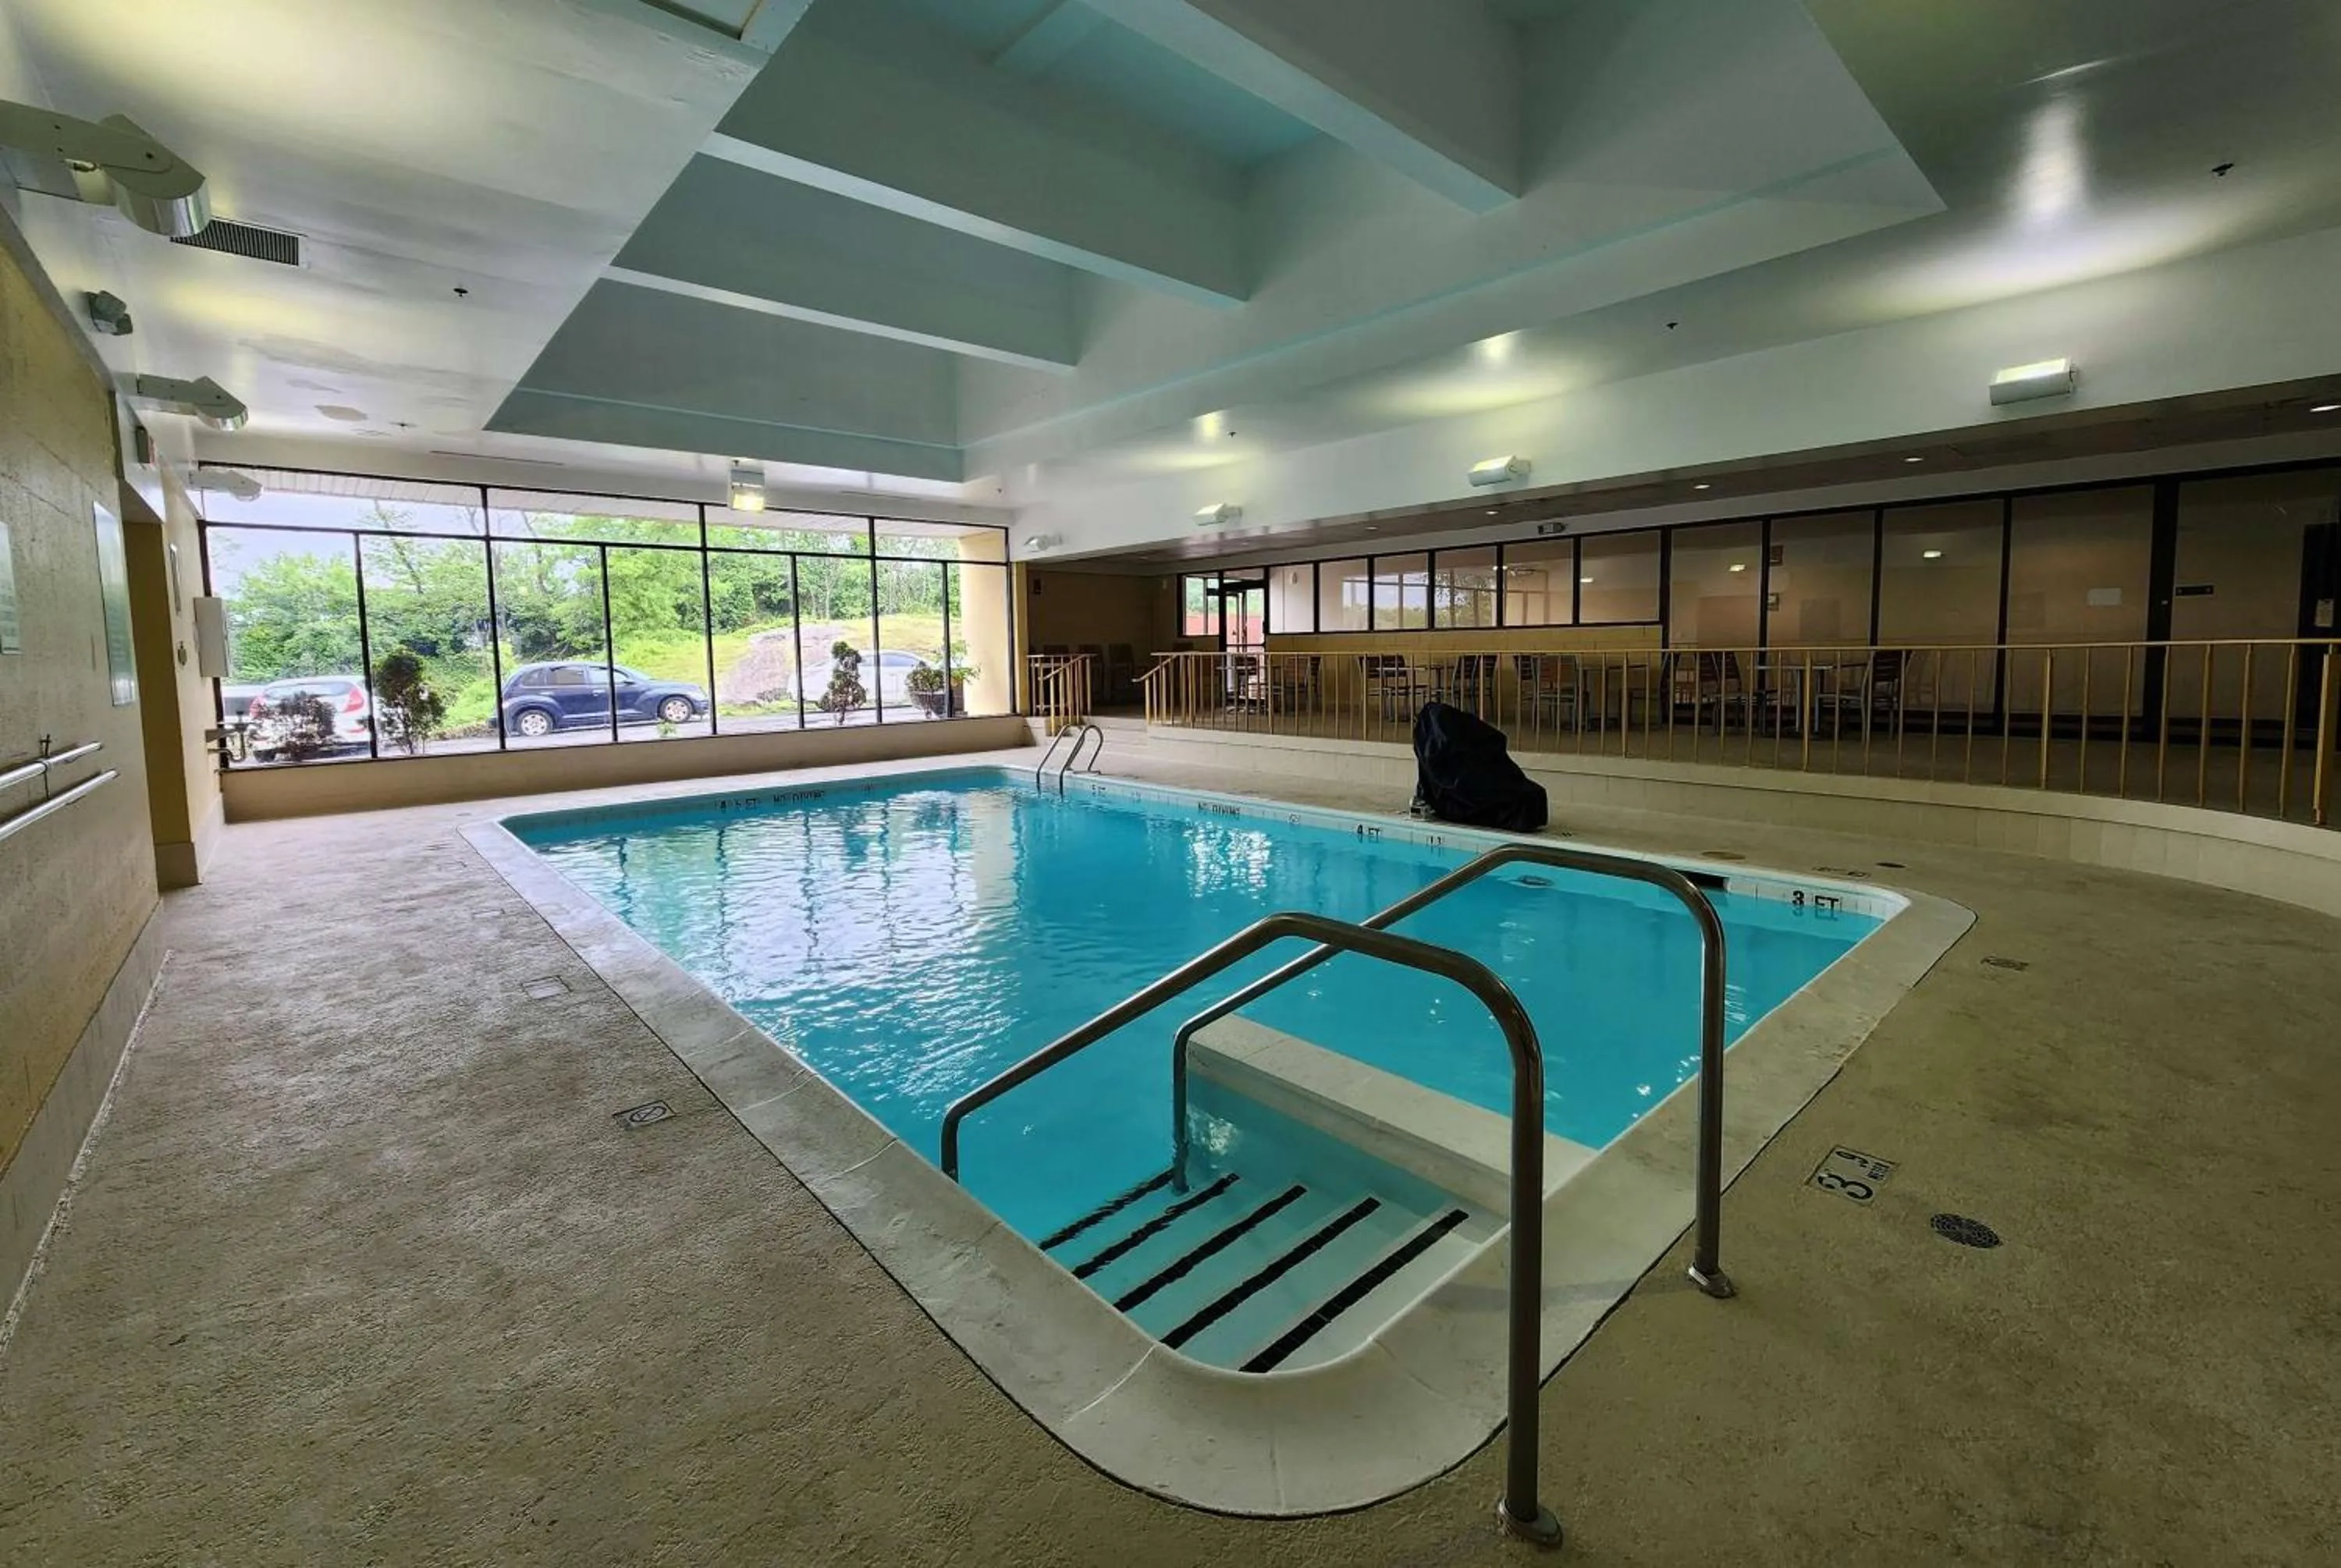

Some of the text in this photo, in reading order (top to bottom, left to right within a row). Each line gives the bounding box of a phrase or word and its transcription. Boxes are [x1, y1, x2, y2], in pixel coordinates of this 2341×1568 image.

[1368, 827, 1380, 838] FT
[1792, 890, 1839, 910] 3 FT
